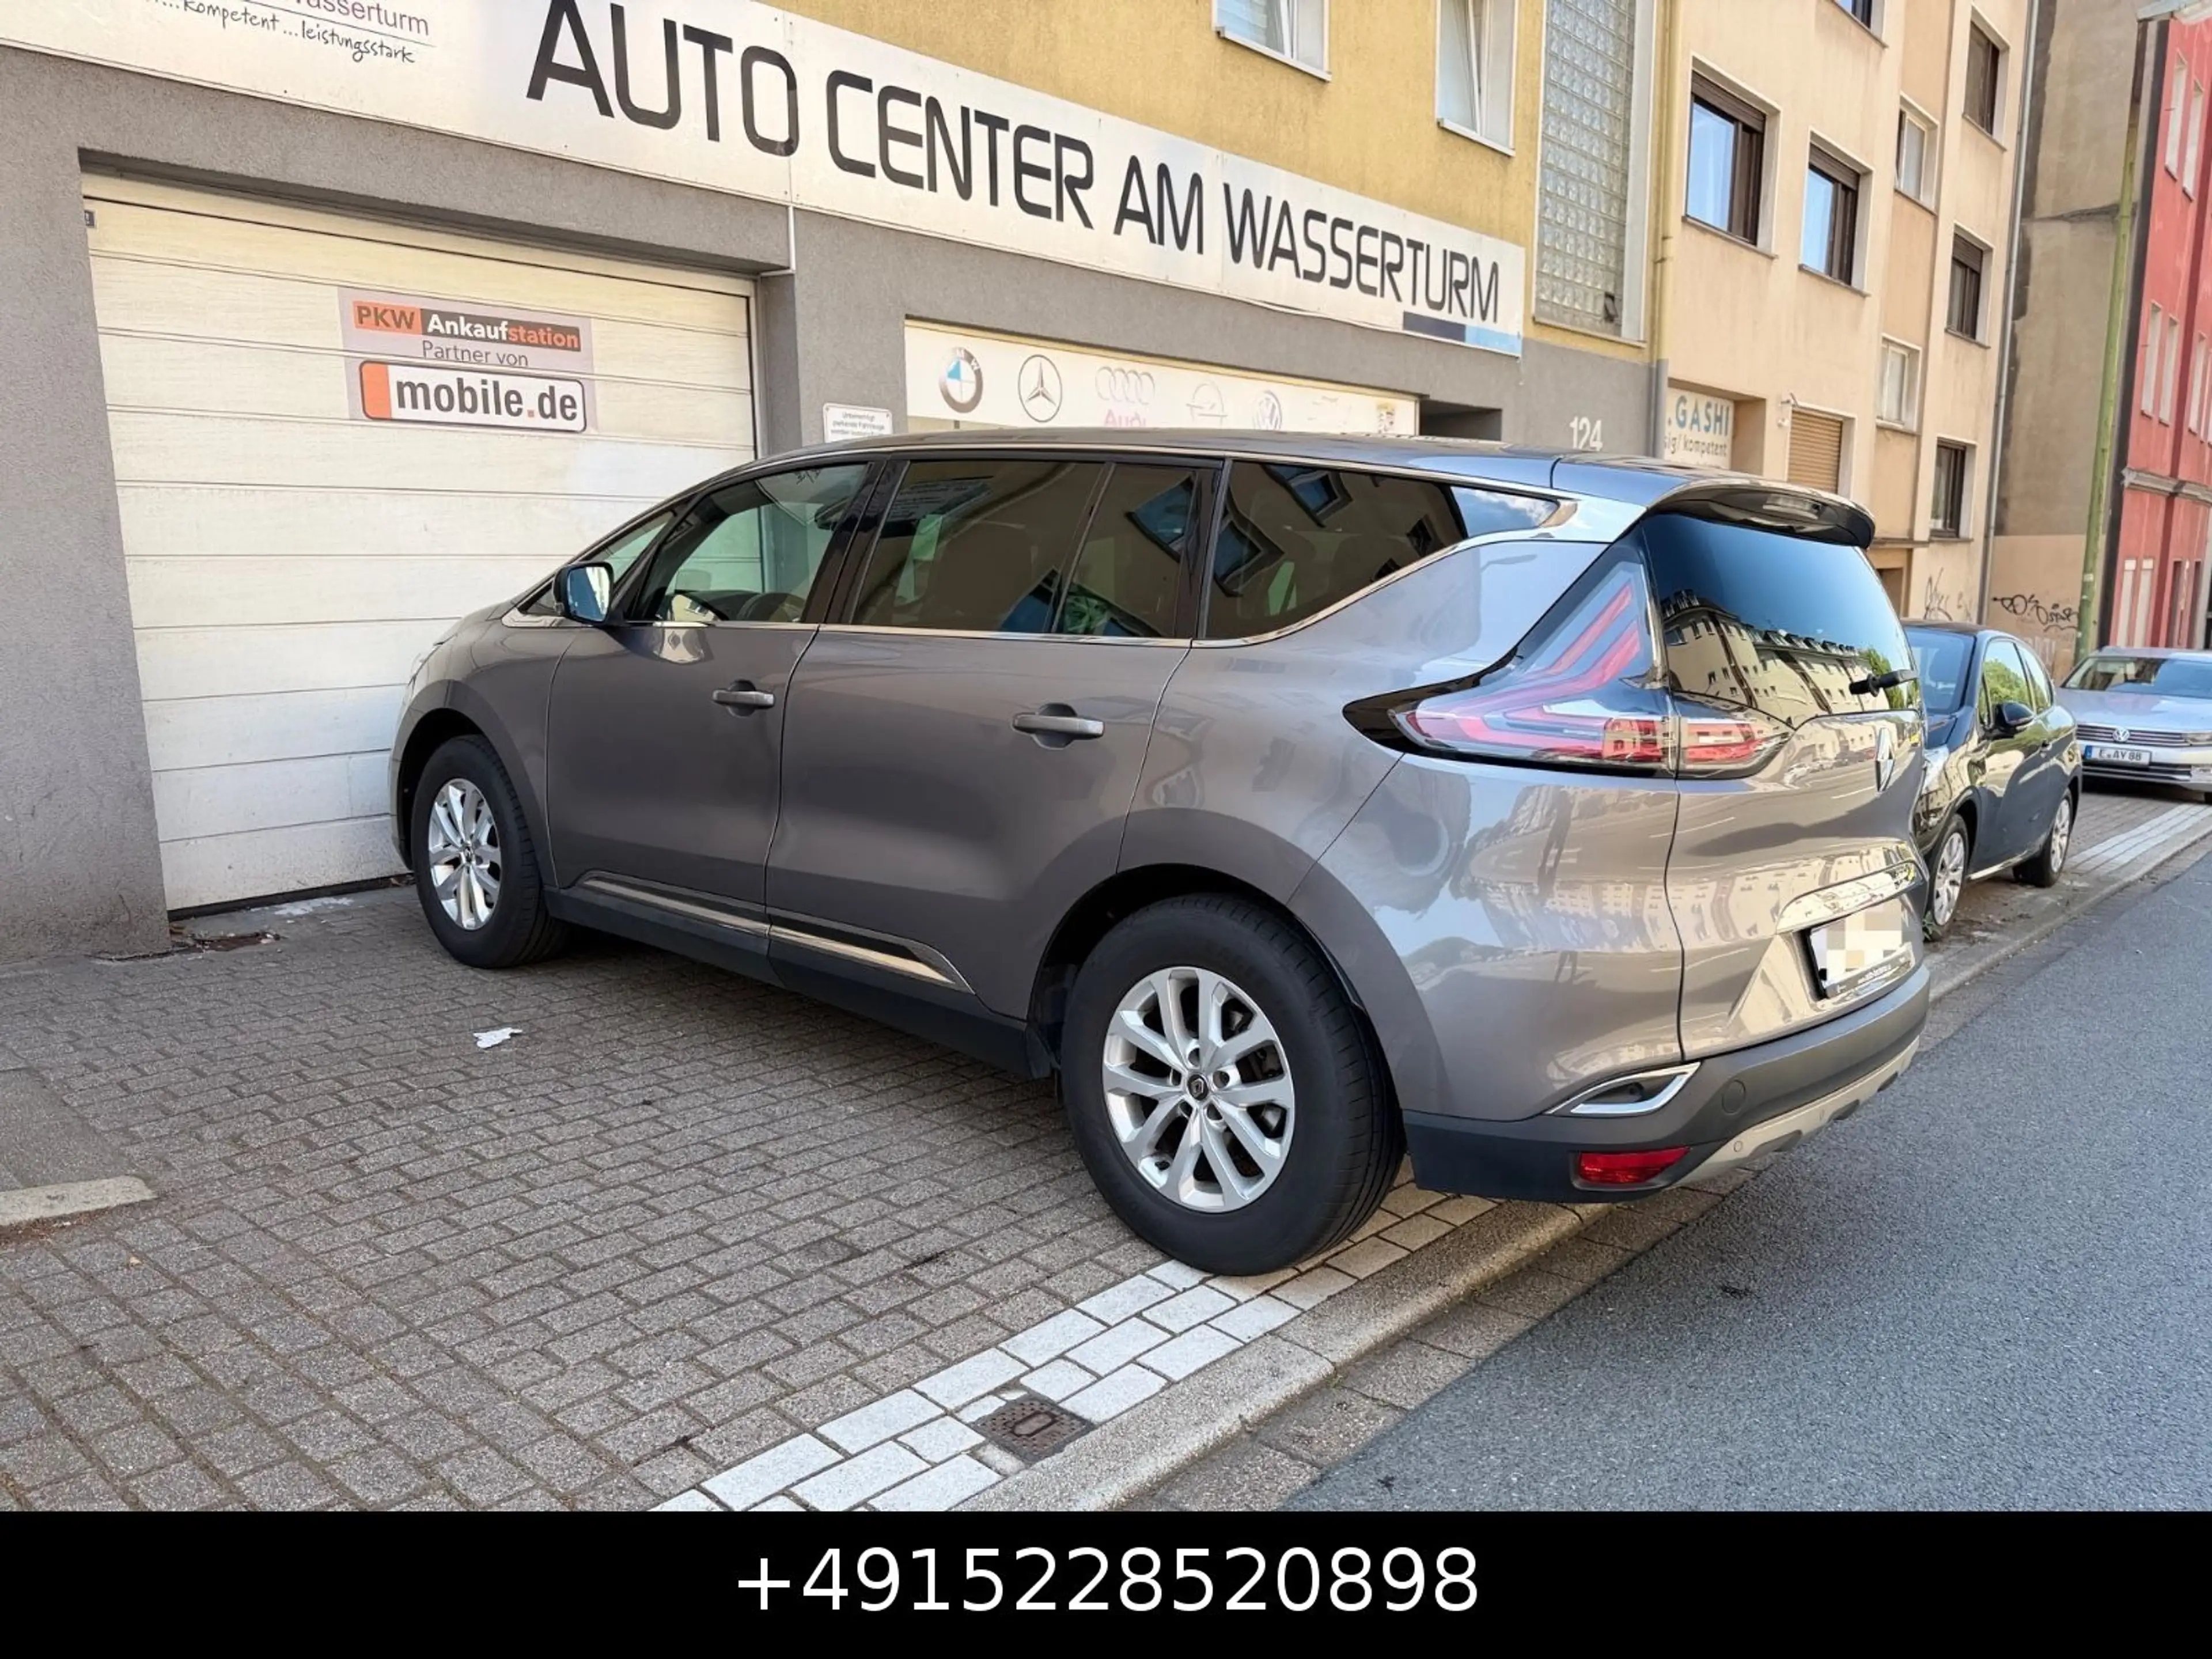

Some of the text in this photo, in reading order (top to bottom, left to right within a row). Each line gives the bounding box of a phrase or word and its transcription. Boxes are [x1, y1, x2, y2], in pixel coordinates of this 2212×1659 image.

[296, 0, 429, 36] asserturm
[527, 0, 1498, 323] AUTO CENTER AM WASSERTURM
[357, 306, 579, 348] PKW Ankaufstation
[422, 340, 528, 367] Partner von
[397, 378, 577, 421] mobile.de
[1104, 409, 1146, 426] Audi
[1569, 415, 1603, 452] 124
